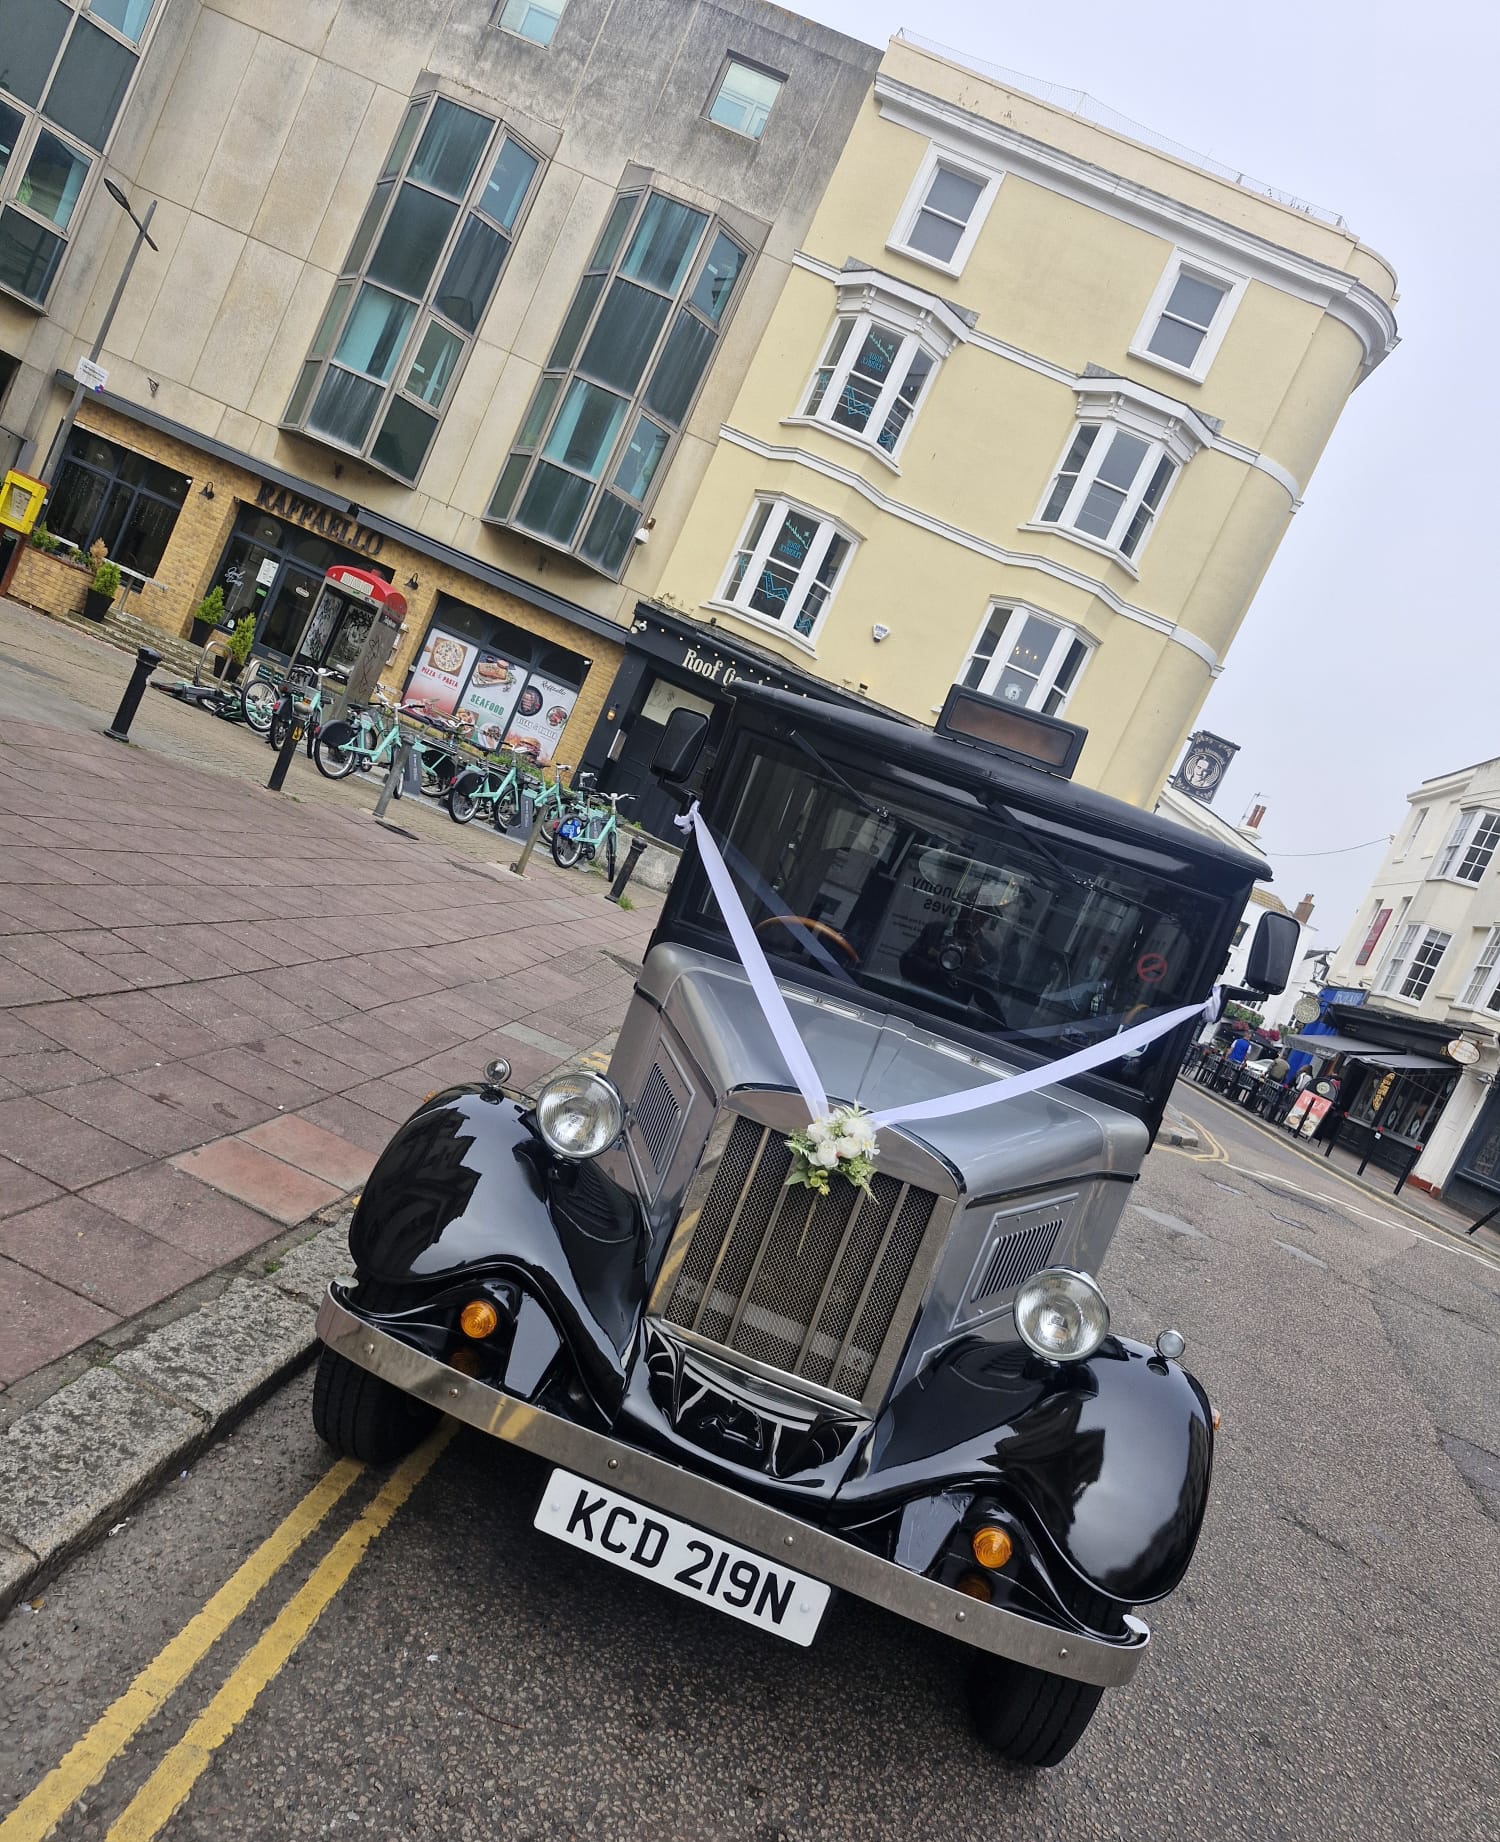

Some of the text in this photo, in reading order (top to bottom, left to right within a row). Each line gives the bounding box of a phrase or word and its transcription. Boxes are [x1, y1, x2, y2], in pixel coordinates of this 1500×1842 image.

[254, 481, 384, 555] RAFFAELLO
[421, 667, 436, 680] PIZZA
[442, 676, 459, 688] PASTA
[682, 648, 723, 681] Roof
[470, 694, 505, 716] SEAFOOD
[566, 1489, 796, 1625] KCD 219N
